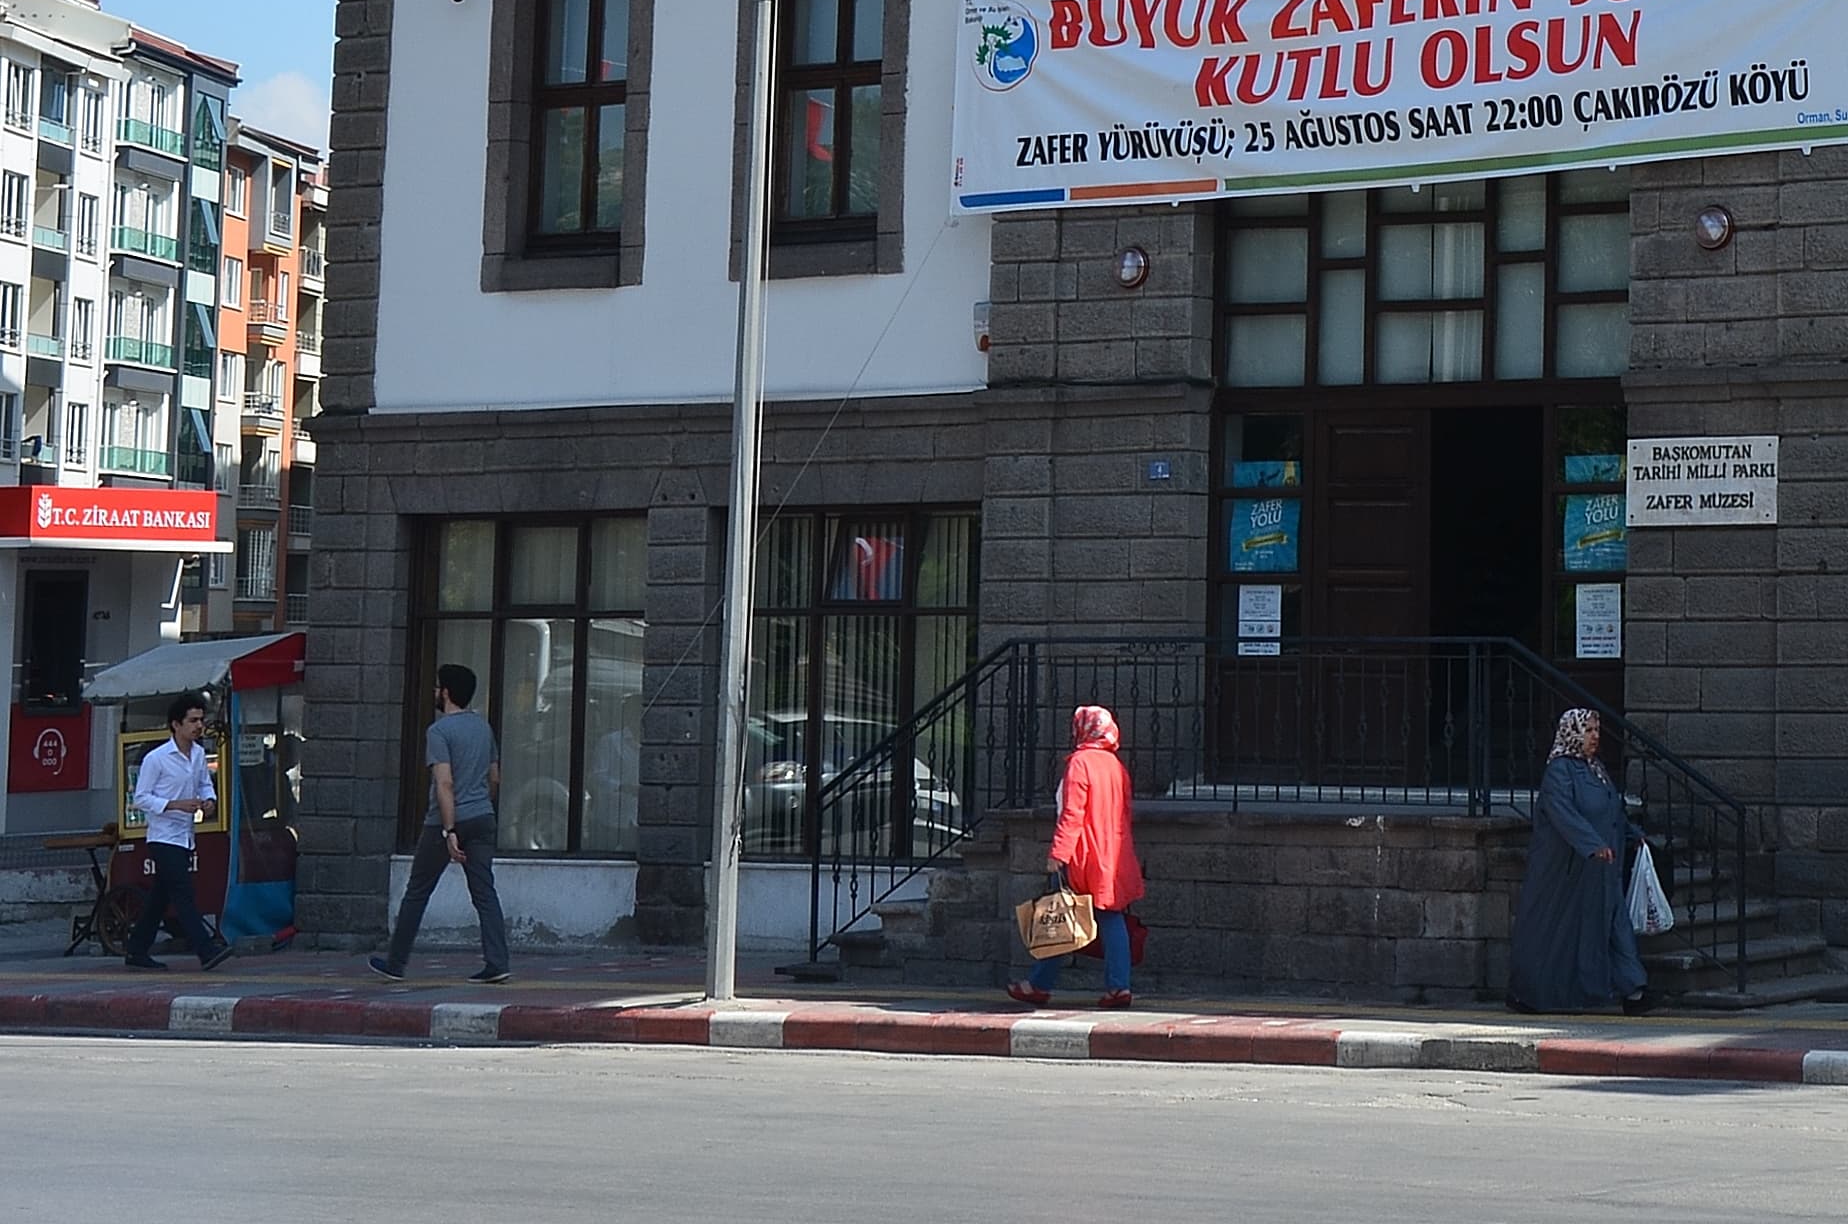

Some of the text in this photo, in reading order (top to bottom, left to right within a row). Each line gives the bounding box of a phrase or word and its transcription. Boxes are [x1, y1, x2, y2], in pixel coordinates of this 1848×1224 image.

[1195, 10, 1640, 108] KUTLU OLSUN
[1016, 60, 1809, 167] ZAFER YÜRÜYÜŞÜ; 25 AĞUSTOS SAAT 22:00 ÇAKIRÖZÜ KÖYÜ
[1797, 112, 1832, 124] Orman,
[1835, 109, 1848, 121] Su
[1652, 444, 1752, 462] BAŞKOMUTAN
[1633, 462, 1776, 480] TARİHİ MİLLİ PARKI
[1251, 498, 1282, 516] ZAFER
[1586, 495, 1618, 512] ZAFER
[1646, 491, 1754, 510] ZAFER MÜZESİ
[52, 504, 210, 529] T.C. ZİRAAT BANKASI
[1250, 510, 1282, 528] YOLU
[1585, 506, 1618, 525] YOLU
